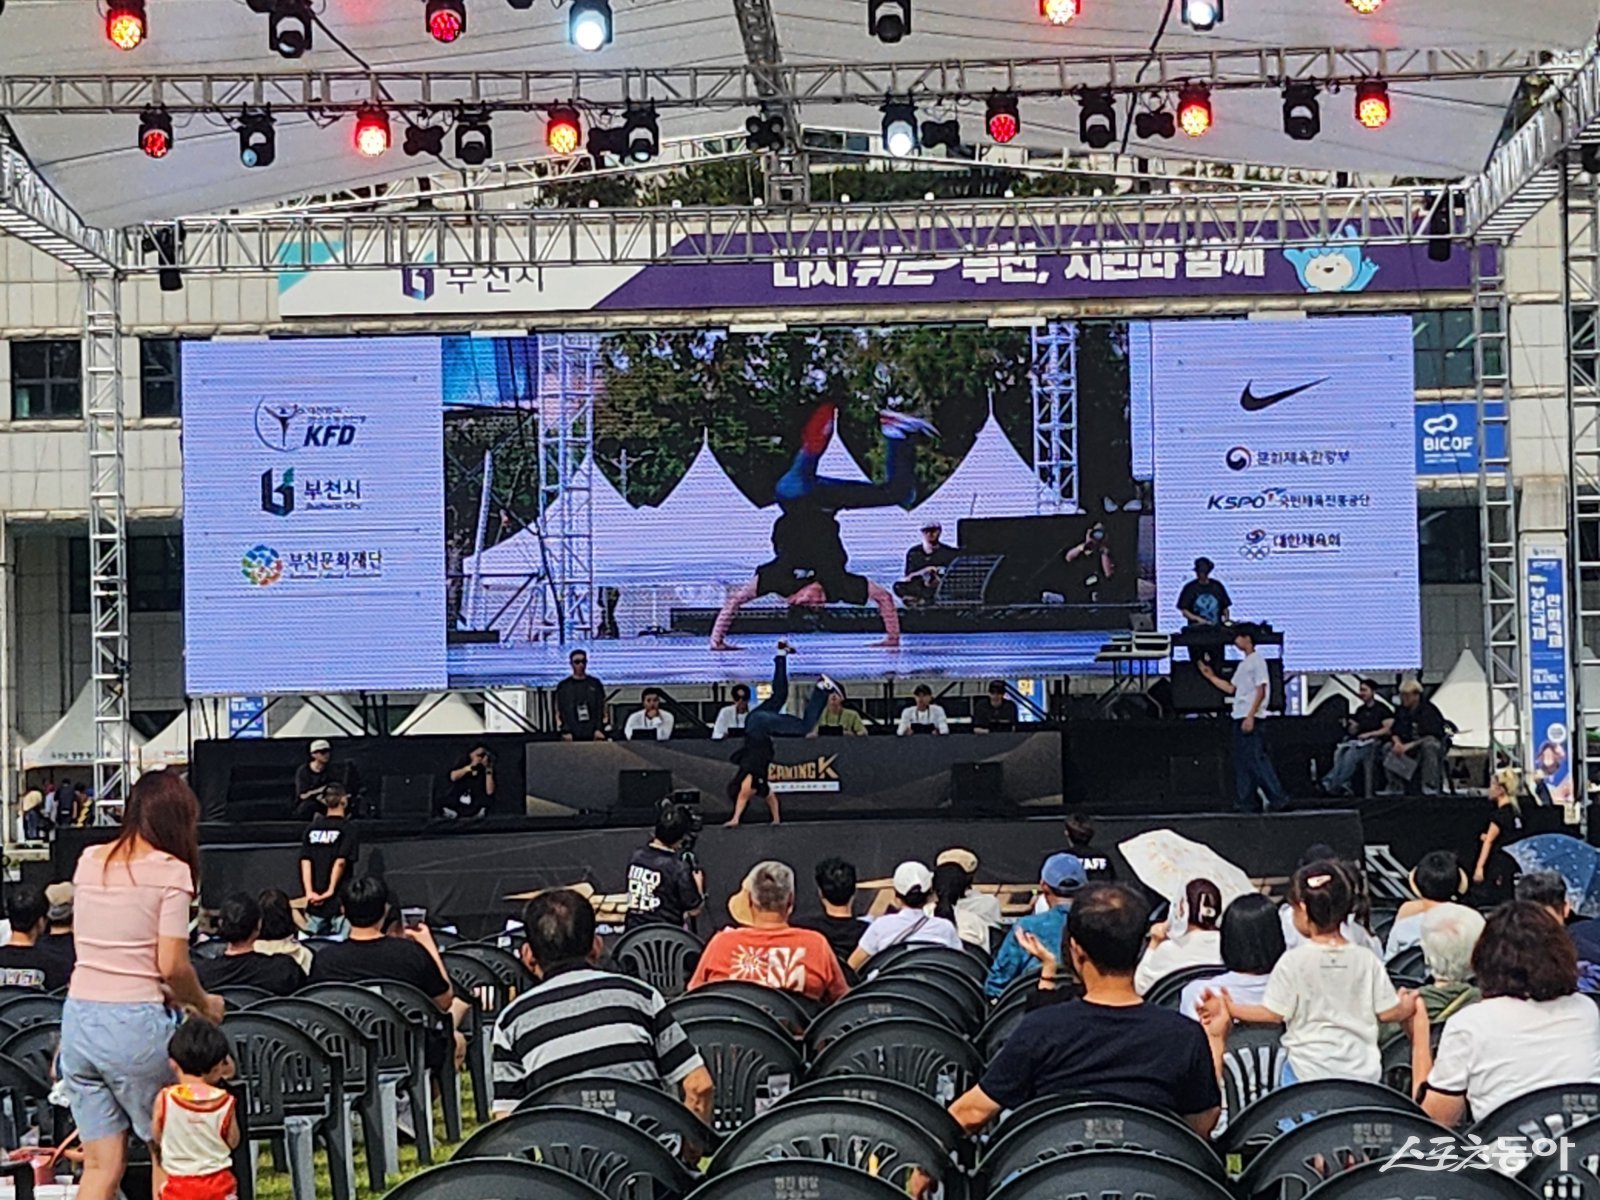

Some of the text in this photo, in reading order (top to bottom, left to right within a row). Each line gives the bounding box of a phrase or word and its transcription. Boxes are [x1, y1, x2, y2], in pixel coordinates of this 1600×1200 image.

[303, 425, 356, 447] KFD
[1423, 436, 1474, 451] BICOF
[1257, 450, 1350, 466] 문화체육관광부
[304, 479, 361, 501] 부천시
[1207, 494, 1370, 510] KSPO 국민체육진흥공단
[1273, 532, 1341, 548] 대한체육회
[288, 551, 383, 571] 부천문화재단
[309, 830, 341, 844] STAFF
